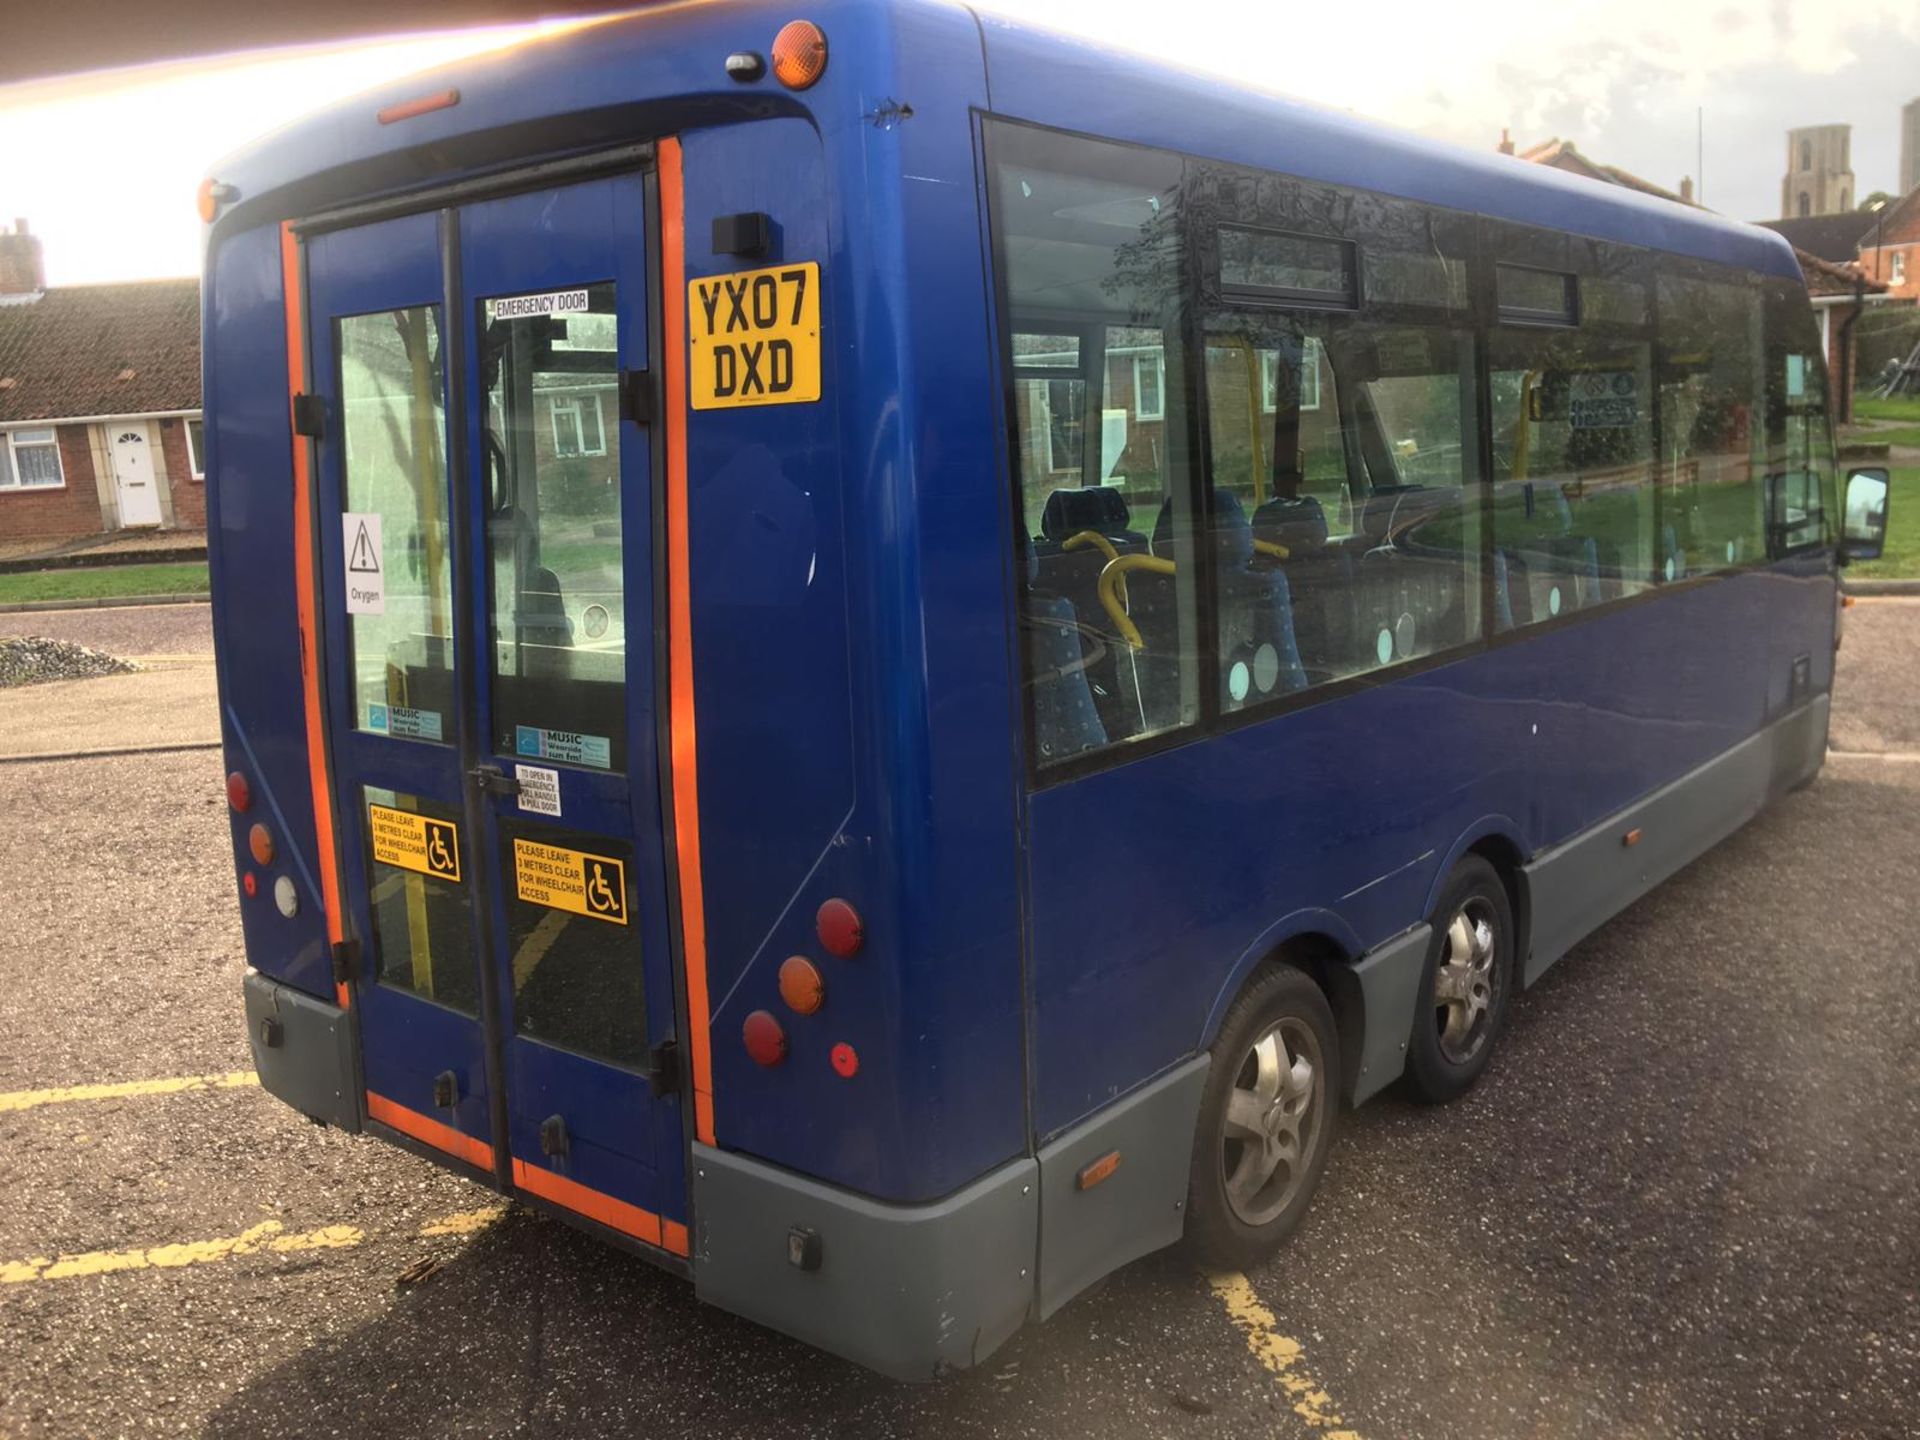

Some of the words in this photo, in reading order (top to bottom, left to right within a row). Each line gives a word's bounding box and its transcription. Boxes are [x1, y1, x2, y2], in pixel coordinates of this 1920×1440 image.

[497, 295, 555, 317] EMERGENCY
[558, 293, 586, 310] DOOR
[698, 269, 806, 335] YX07
[713, 339, 793, 398] DXD
[351, 587, 380, 603] Oxygen
[393, 707, 420, 719] MUSIC
[547, 731, 582, 745] MUSIC
[547, 742, 582, 753] Wearside
[548, 751, 564, 760] sun
[566, 752, 582, 762] fm!
[521, 768, 528, 778] TO
[529, 769, 546, 780] OPEN
[546, 773, 553, 782] IN
[534, 790, 557, 802] HANDLE
[526, 798, 540, 809] PULL
[541, 801, 557, 812] DOOR
[372, 809, 395, 823] PLEASE
[396, 815, 415, 827] LEAVE
[378, 824, 402, 837] METRES
[402, 829, 423, 842] CLEAR
[375, 834, 387, 845] FOR
[388, 838, 427, 856] WHEELCHAIR
[376, 848, 400, 862] ACCESS
[516, 843, 545, 859] PLEASE
[546, 850, 571, 864] LEAVE
[518, 857, 523, 867] 3
[523, 859, 553, 874] METRES
[554, 866, 580, 880] CLEAR
[519, 871, 534, 884] FOR
[536, 877, 585, 896] WHEELCHAIR
[520, 887, 550, 902] ACCESS
